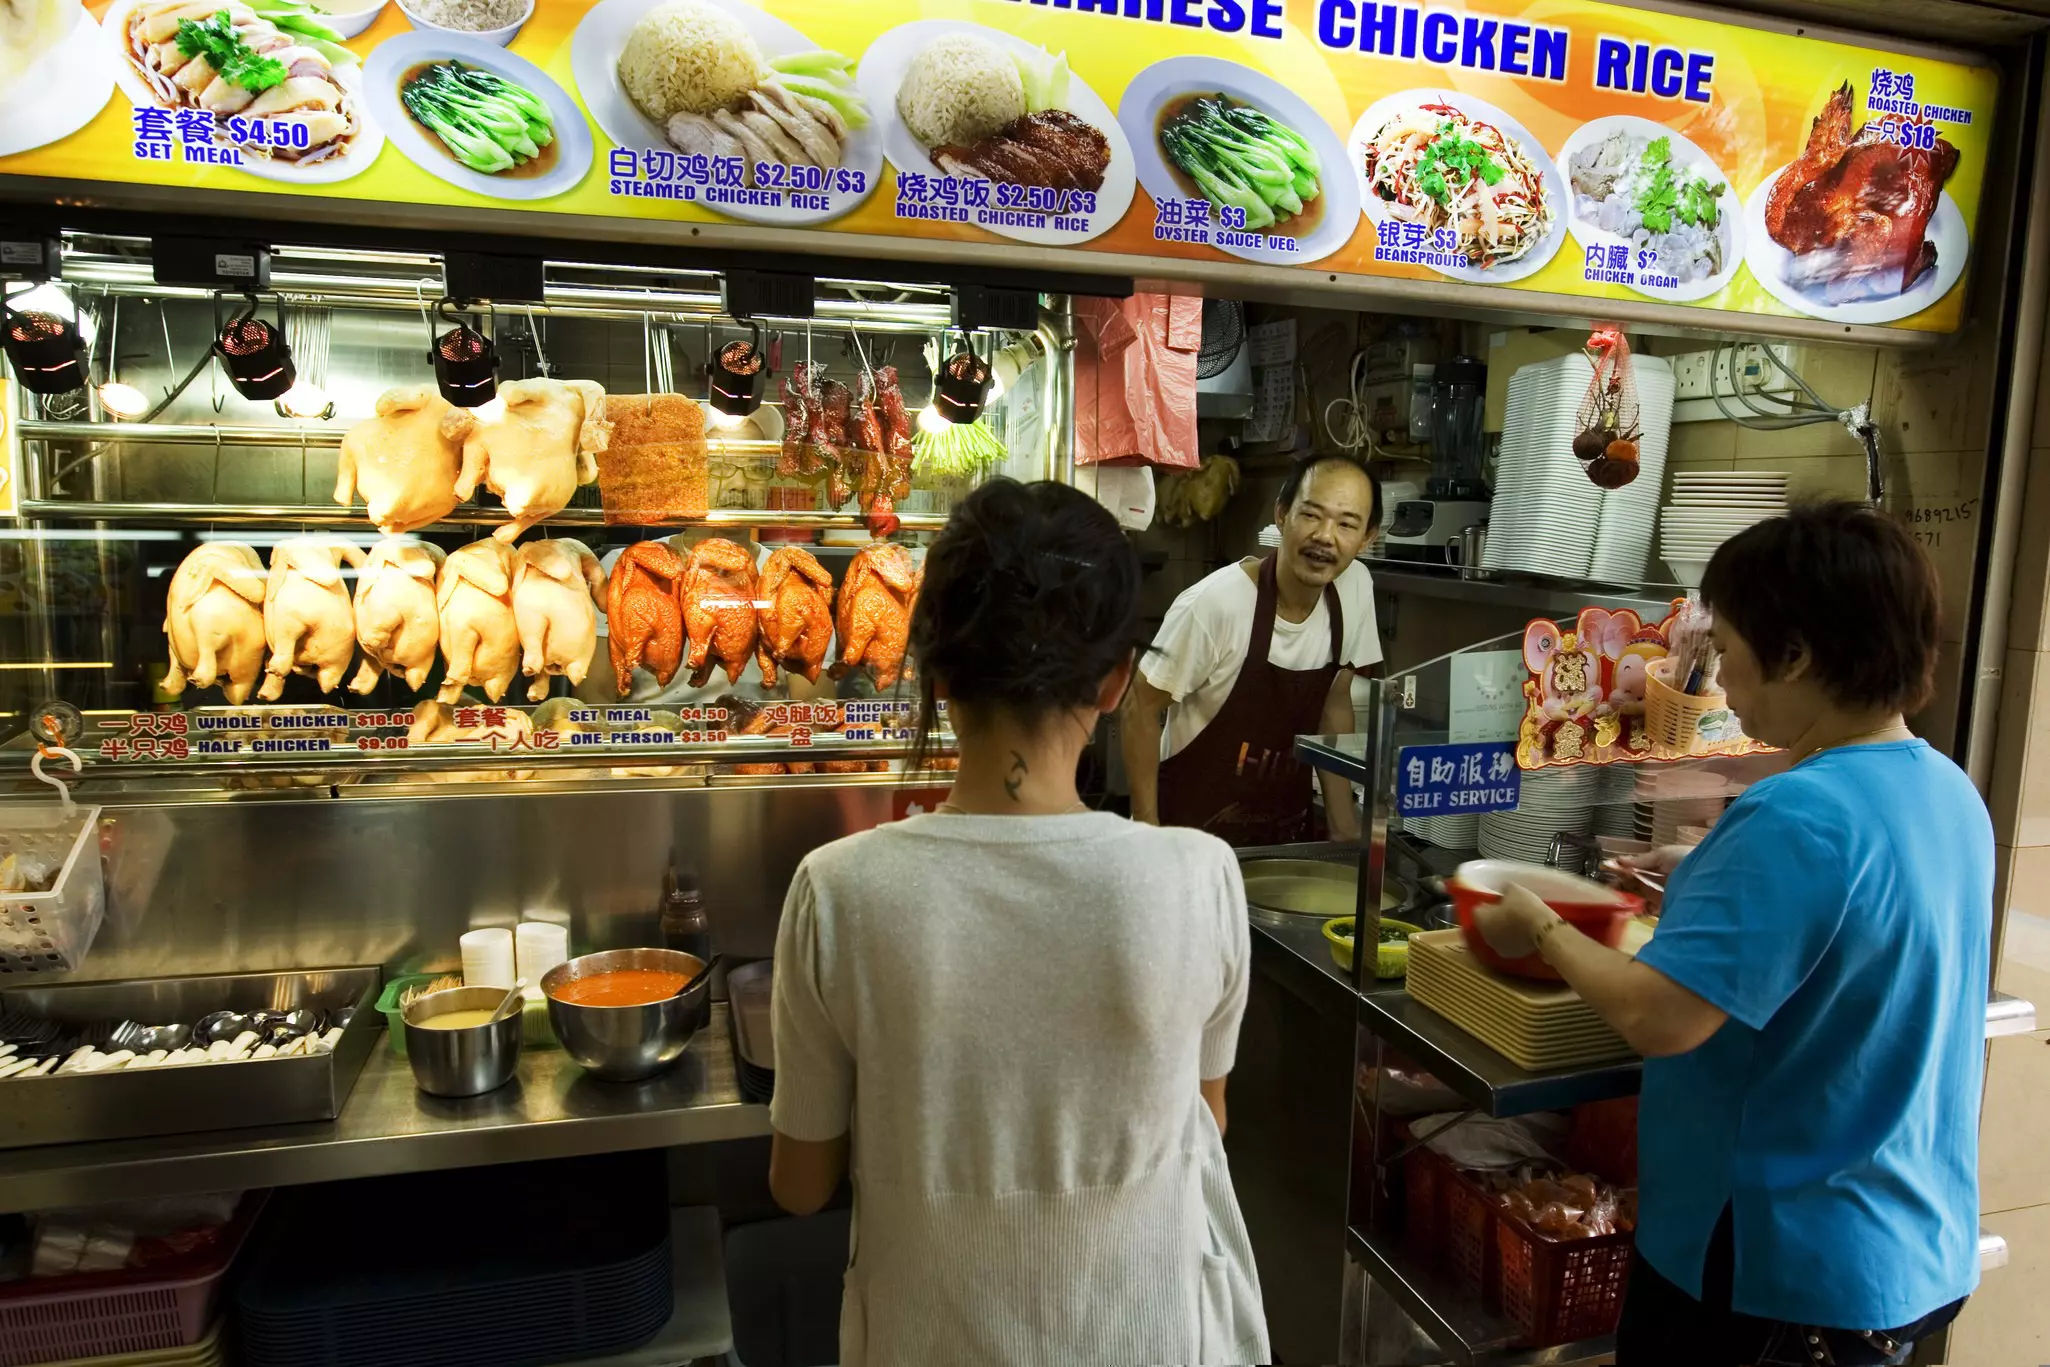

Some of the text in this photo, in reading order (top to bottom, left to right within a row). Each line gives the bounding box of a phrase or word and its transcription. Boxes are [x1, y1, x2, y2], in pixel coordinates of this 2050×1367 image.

[1318, 0, 1568, 80] CHICKEN
[1597, 39, 1714, 103] RICE
[1870, 68, 1914, 101] 烧鸡
[1868, 96, 1972, 124] ROASTED CHICKEN
[134, 106, 309, 148] 套餐 $4.50
[1865, 122, 1935, 150] 一只 $18
[135, 142, 244, 165] SET MEAL
[610, 147, 866, 194] 白切鸡饭 $2.50/$3
[610, 179, 830, 211] STEAMED CHICKEN RICE
[897, 172, 1097, 214] 烧鸡饭 $2.50/$3
[896, 202, 1089, 232] ROASTED CHICKEN RICE
[1155, 197, 1246, 228] 油菜 $3
[1154, 225, 1300, 252] OYSTER SAUCE VEG.
[1377, 220, 1457, 250] 银芽 $3
[1375, 247, 1467, 268] BEANSPROUTS
[1638, 250, 1658, 270] $2
[1585, 268, 1678, 289] CHICKEN ORGAN
[98, 713, 415, 737] 一只鸡 WHOLE CHICKEN $18.00
[455, 708, 728, 728] 套餐 SET MEAL $4.50
[765, 704, 837, 724] 鸡腿饭
[845, 703, 910, 712] CHICKEN
[845, 714, 880, 723] RICE
[101, 737, 409, 762] 半只鸡 HALF CHICKEN $9.00
[455, 729, 727, 751] 一个人吃 ONE PERSON $3.50
[766, 727, 918, 746] 一盘 ONE PLAT
[1403, 788, 1515, 810] SELF SERVICE
